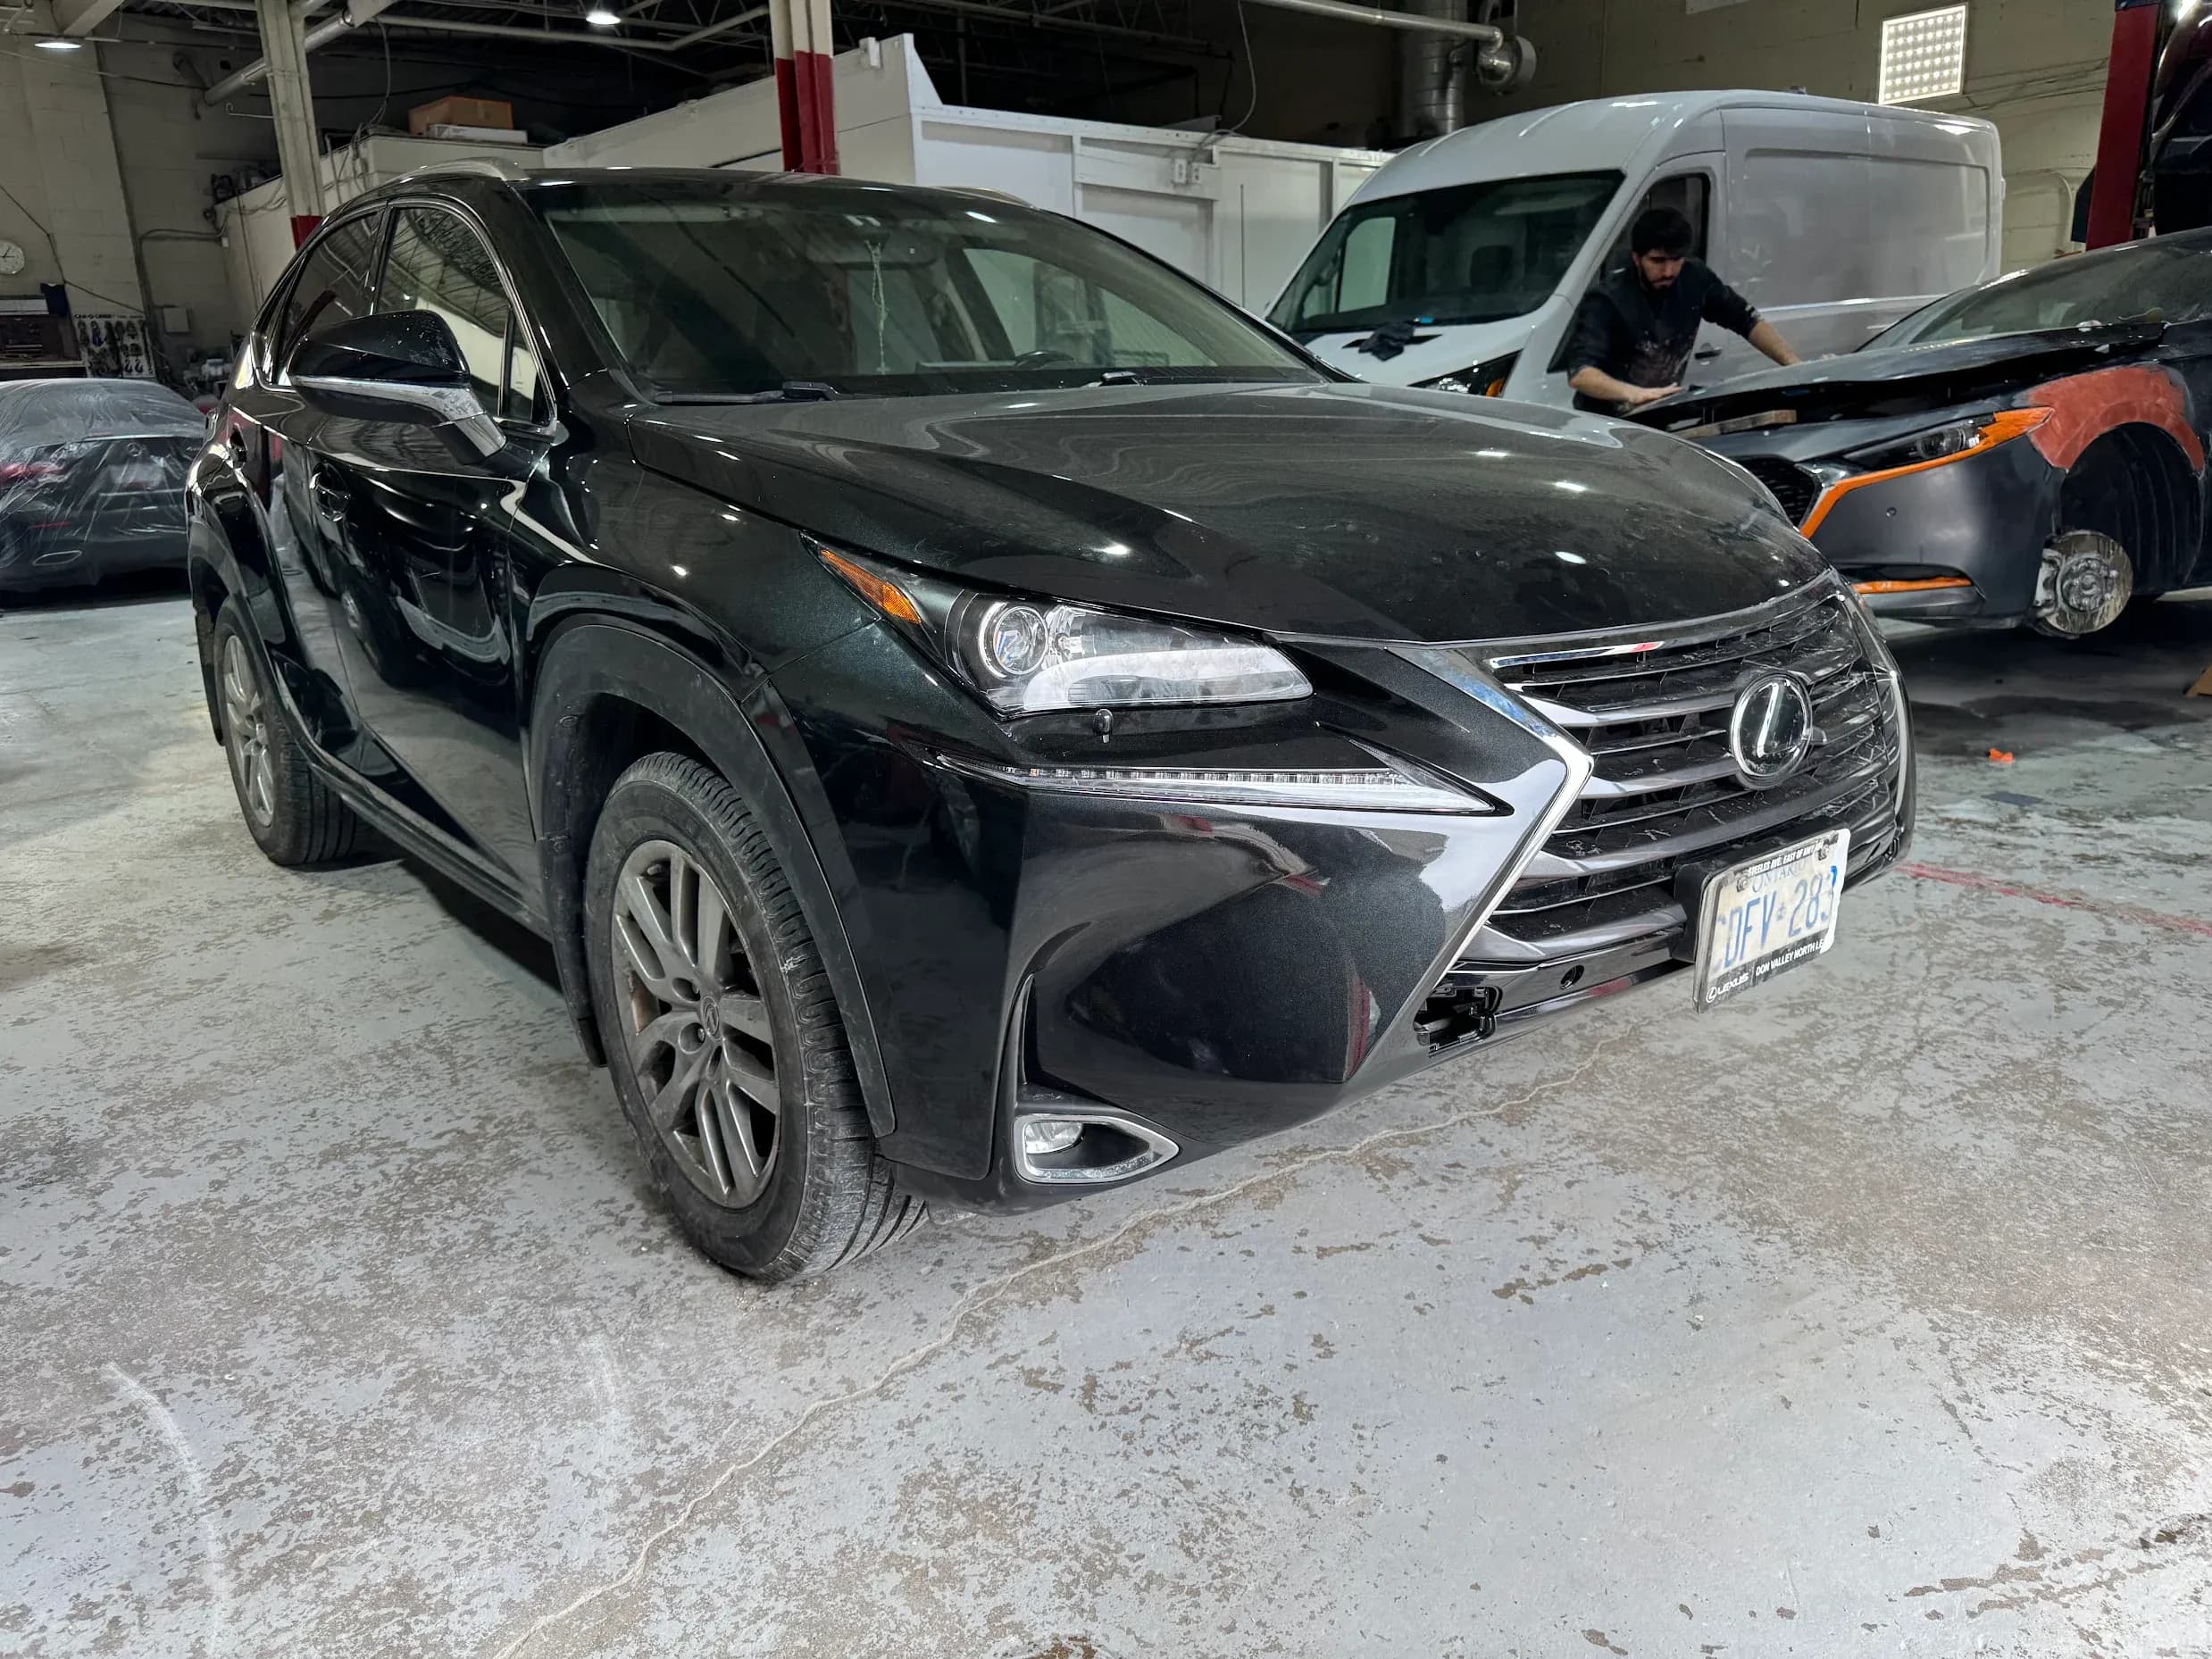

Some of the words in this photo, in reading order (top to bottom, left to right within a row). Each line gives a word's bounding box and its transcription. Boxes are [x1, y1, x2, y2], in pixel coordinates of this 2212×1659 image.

[1749, 861, 1771, 874] STEELES
[1783, 851, 1796, 864] EAST
[1796, 849, 1804, 859] OF
[1716, 972, 1749, 995] LEXUS
[1756, 962, 1770, 976] DON
[1771, 951, 1794, 970] VALLEY
[1794, 942, 1816, 959] NORTH
